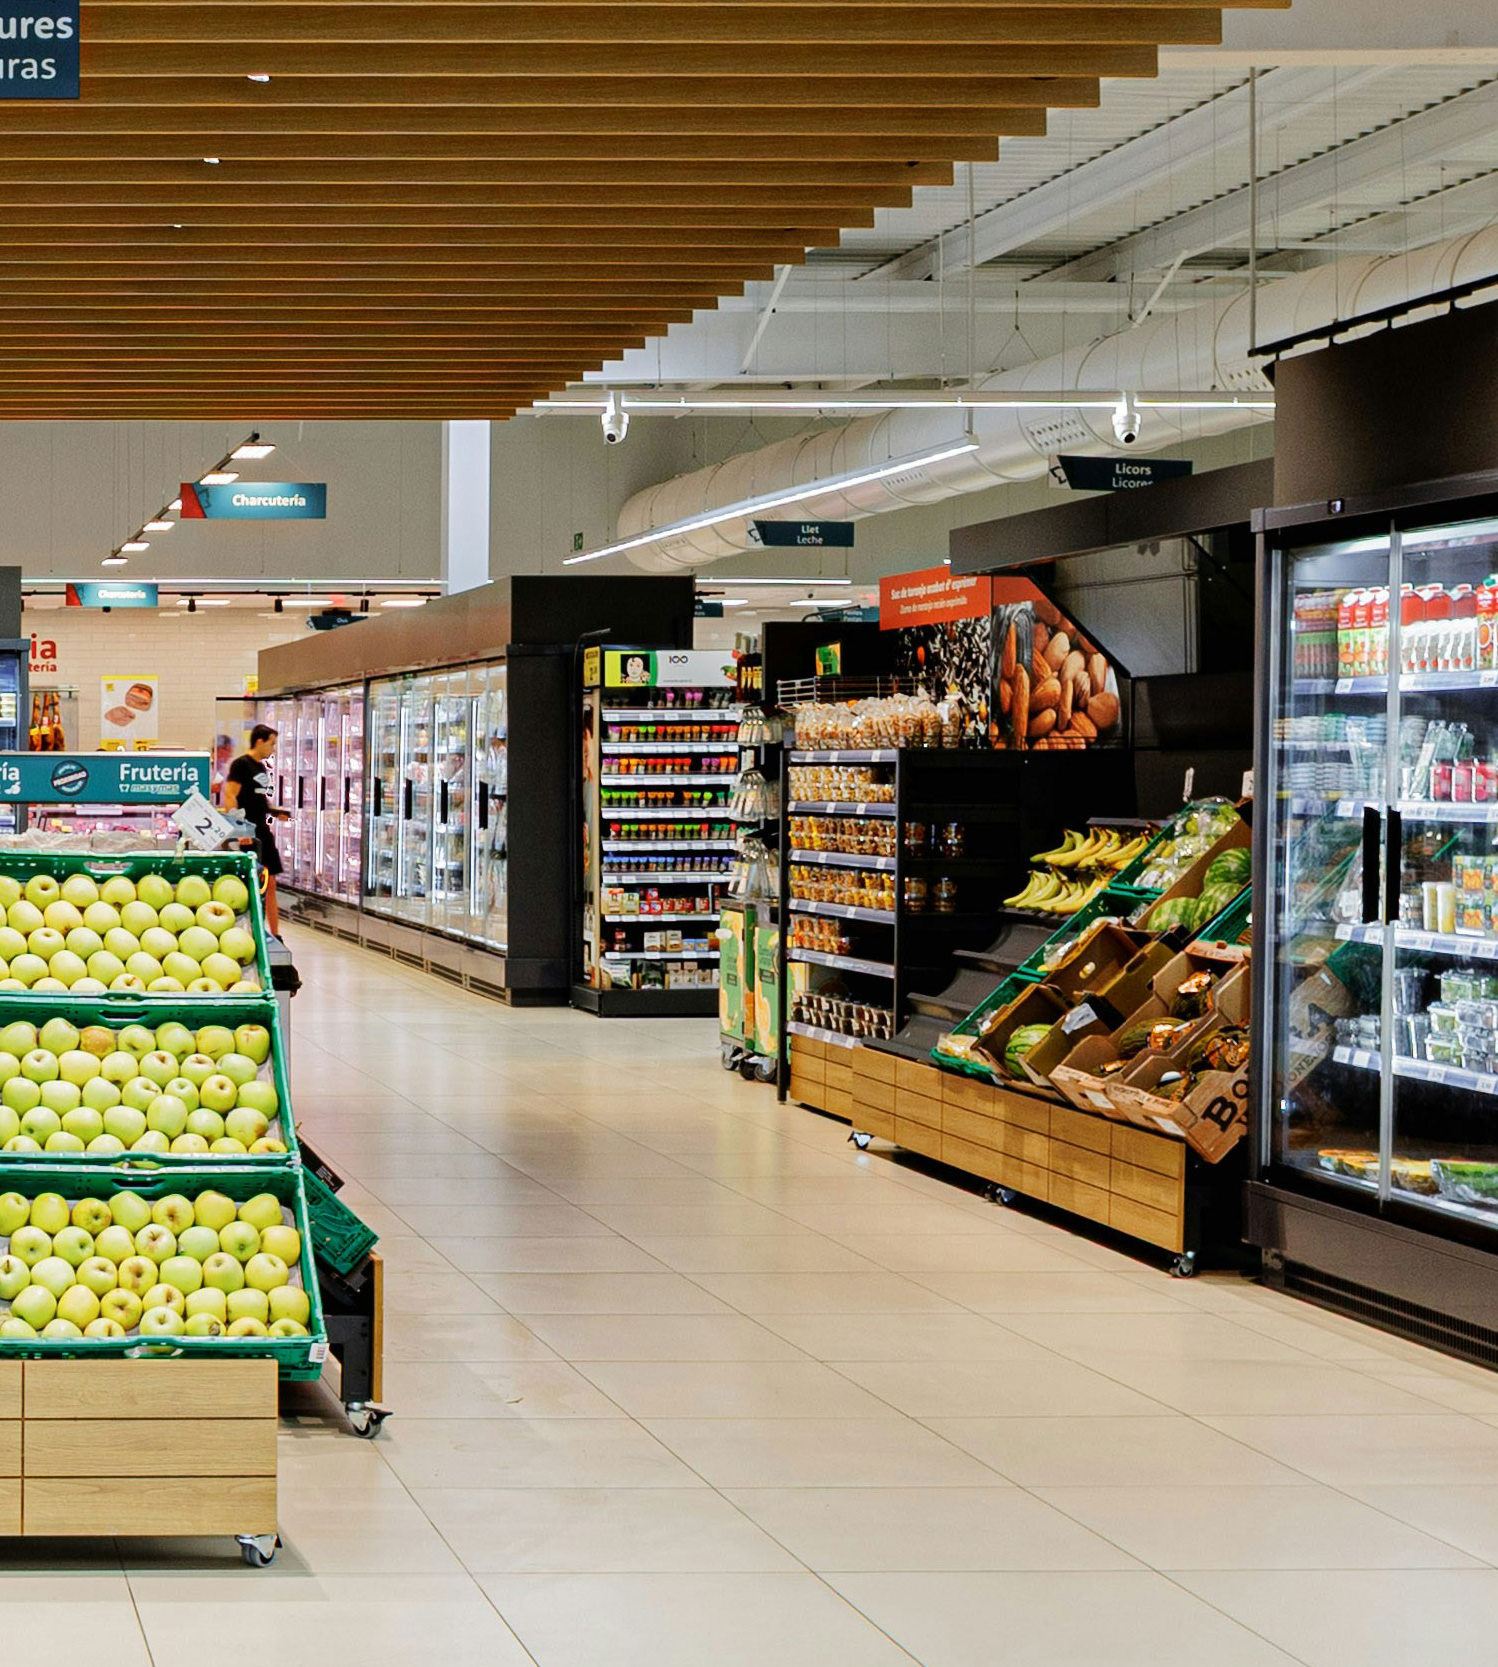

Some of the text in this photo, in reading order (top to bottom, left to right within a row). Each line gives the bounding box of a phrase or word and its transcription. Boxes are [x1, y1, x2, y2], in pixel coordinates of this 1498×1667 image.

[1115, 463, 1152, 475] Licors
[232, 493, 306, 508] Charcutería
[797, 535, 823, 545] Leche
[120, 762, 200, 781] Frutería
